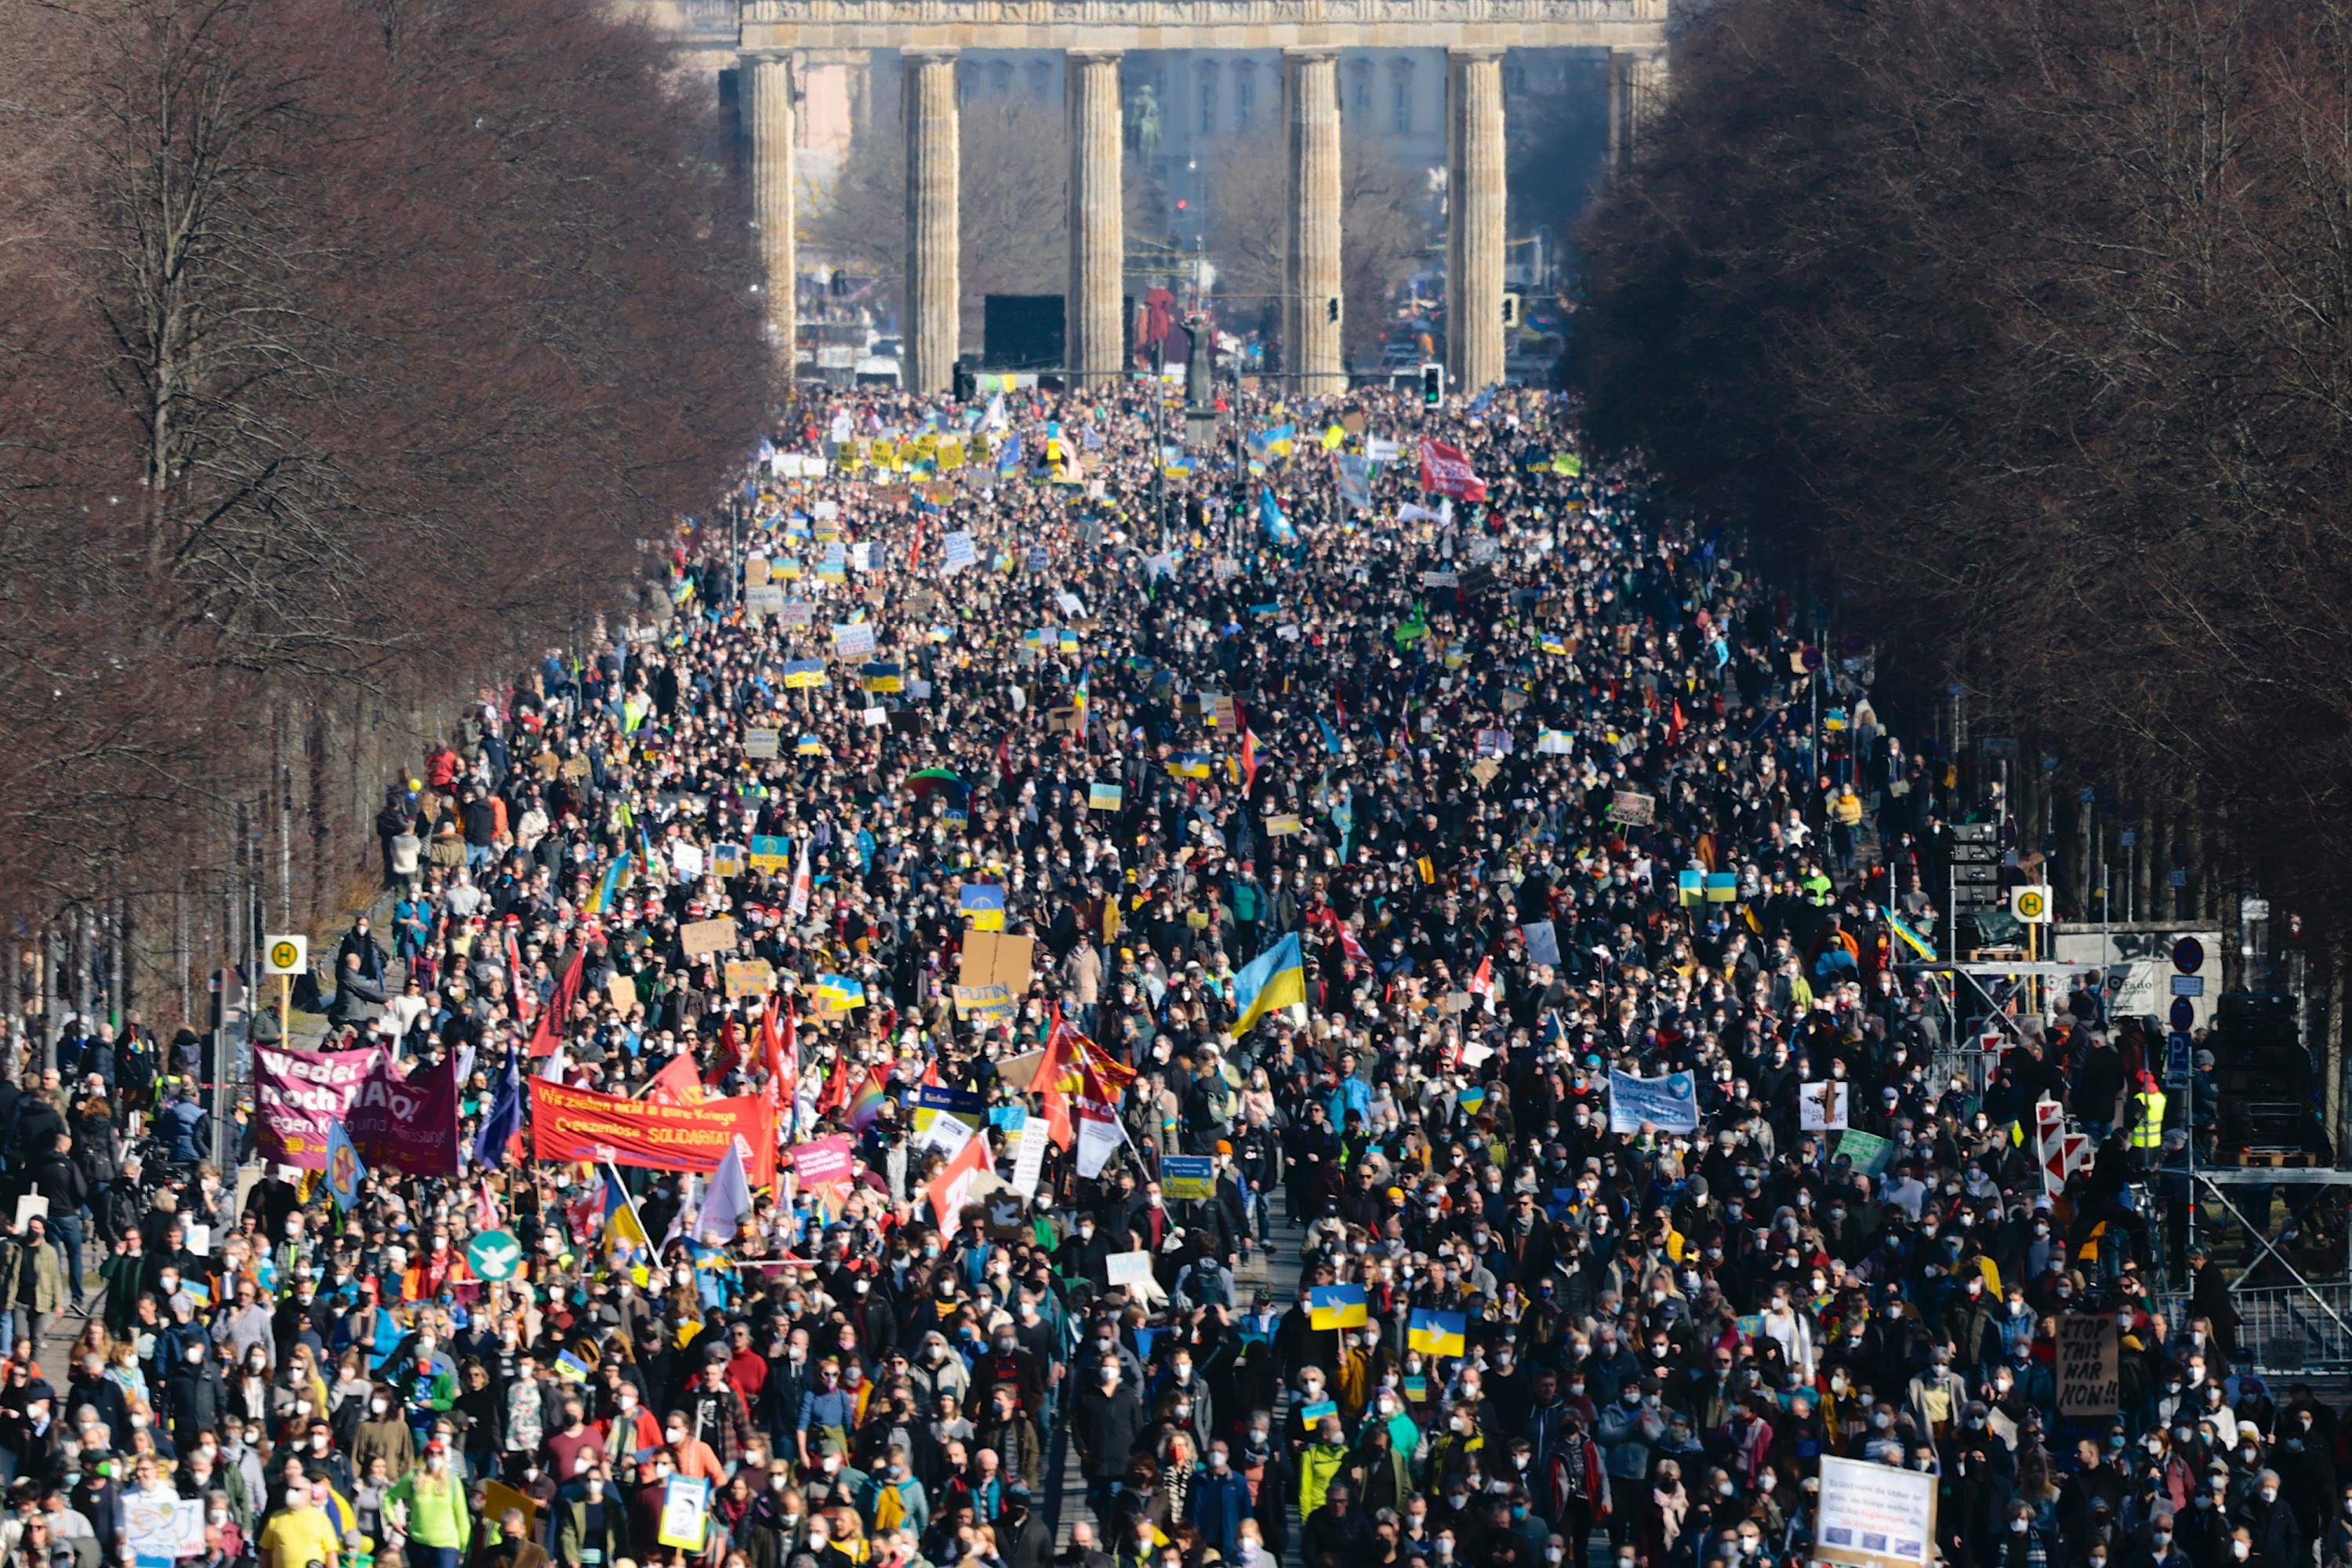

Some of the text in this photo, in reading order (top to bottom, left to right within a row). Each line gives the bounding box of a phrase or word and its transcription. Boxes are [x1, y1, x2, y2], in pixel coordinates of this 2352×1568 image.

[2025, 897, 2037, 912] H
[278, 946, 291, 963] H
[957, 981, 1009, 1000] PUTIN
[2170, 1036, 2184, 1065] P
[261, 1050, 361, 1083] Weder
[260, 1083, 337, 1112] noch
[537, 1086, 563, 1107] Wir
[565, 1094, 611, 1112] ziehen
[693, 1107, 738, 1127] Kriege
[260, 1109, 314, 1134] Gegen
[2060, 1318, 2110, 1339] STOP
[2063, 1341, 2103, 1361] THIS
